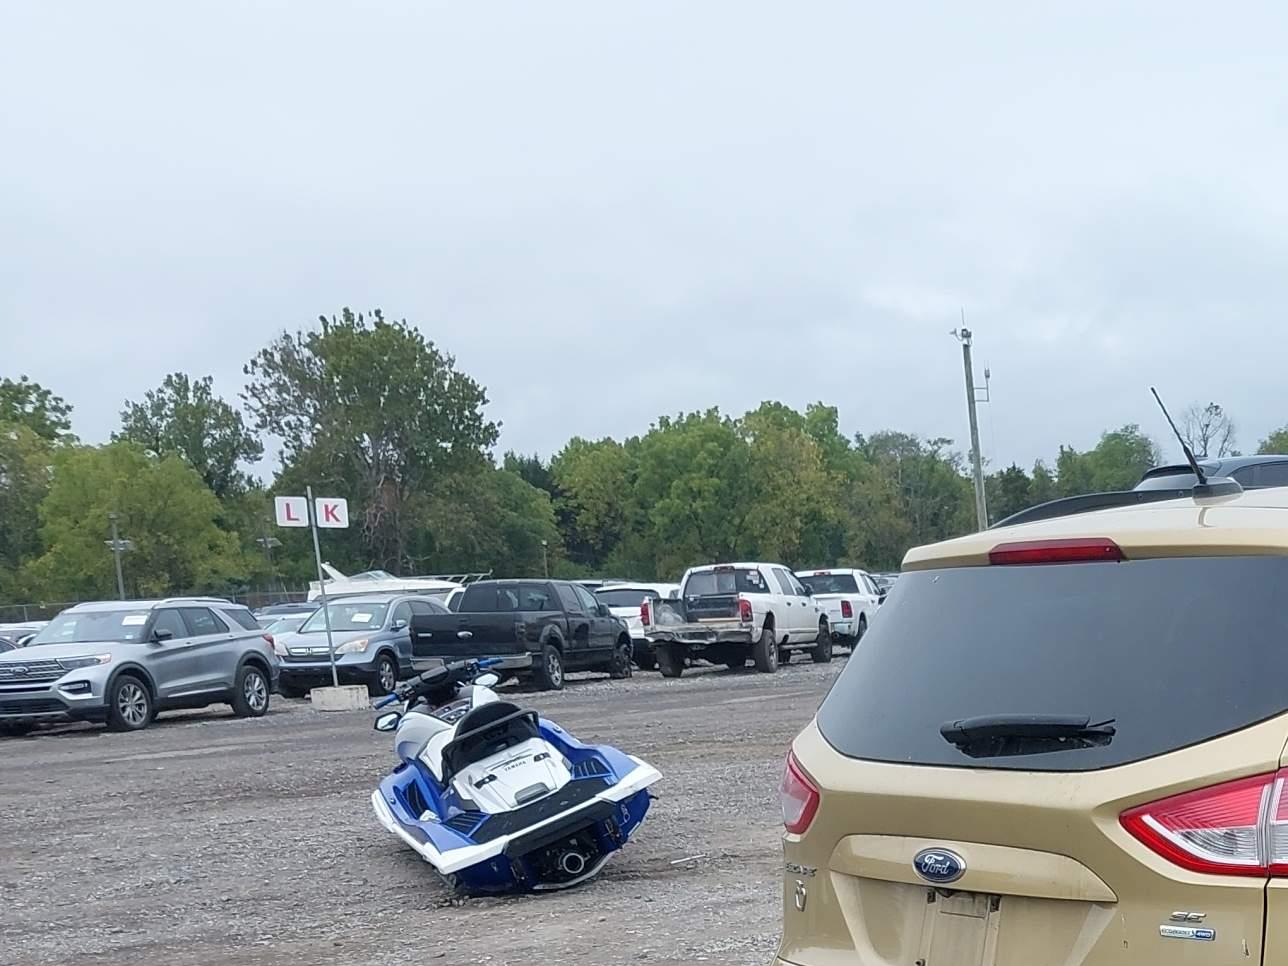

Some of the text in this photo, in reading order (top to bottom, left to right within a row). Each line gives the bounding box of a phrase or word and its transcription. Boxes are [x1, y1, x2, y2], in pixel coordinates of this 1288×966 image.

[285, 502, 300, 521] L
[324, 504, 341, 522] K
[1169, 911, 1207, 924] SE
